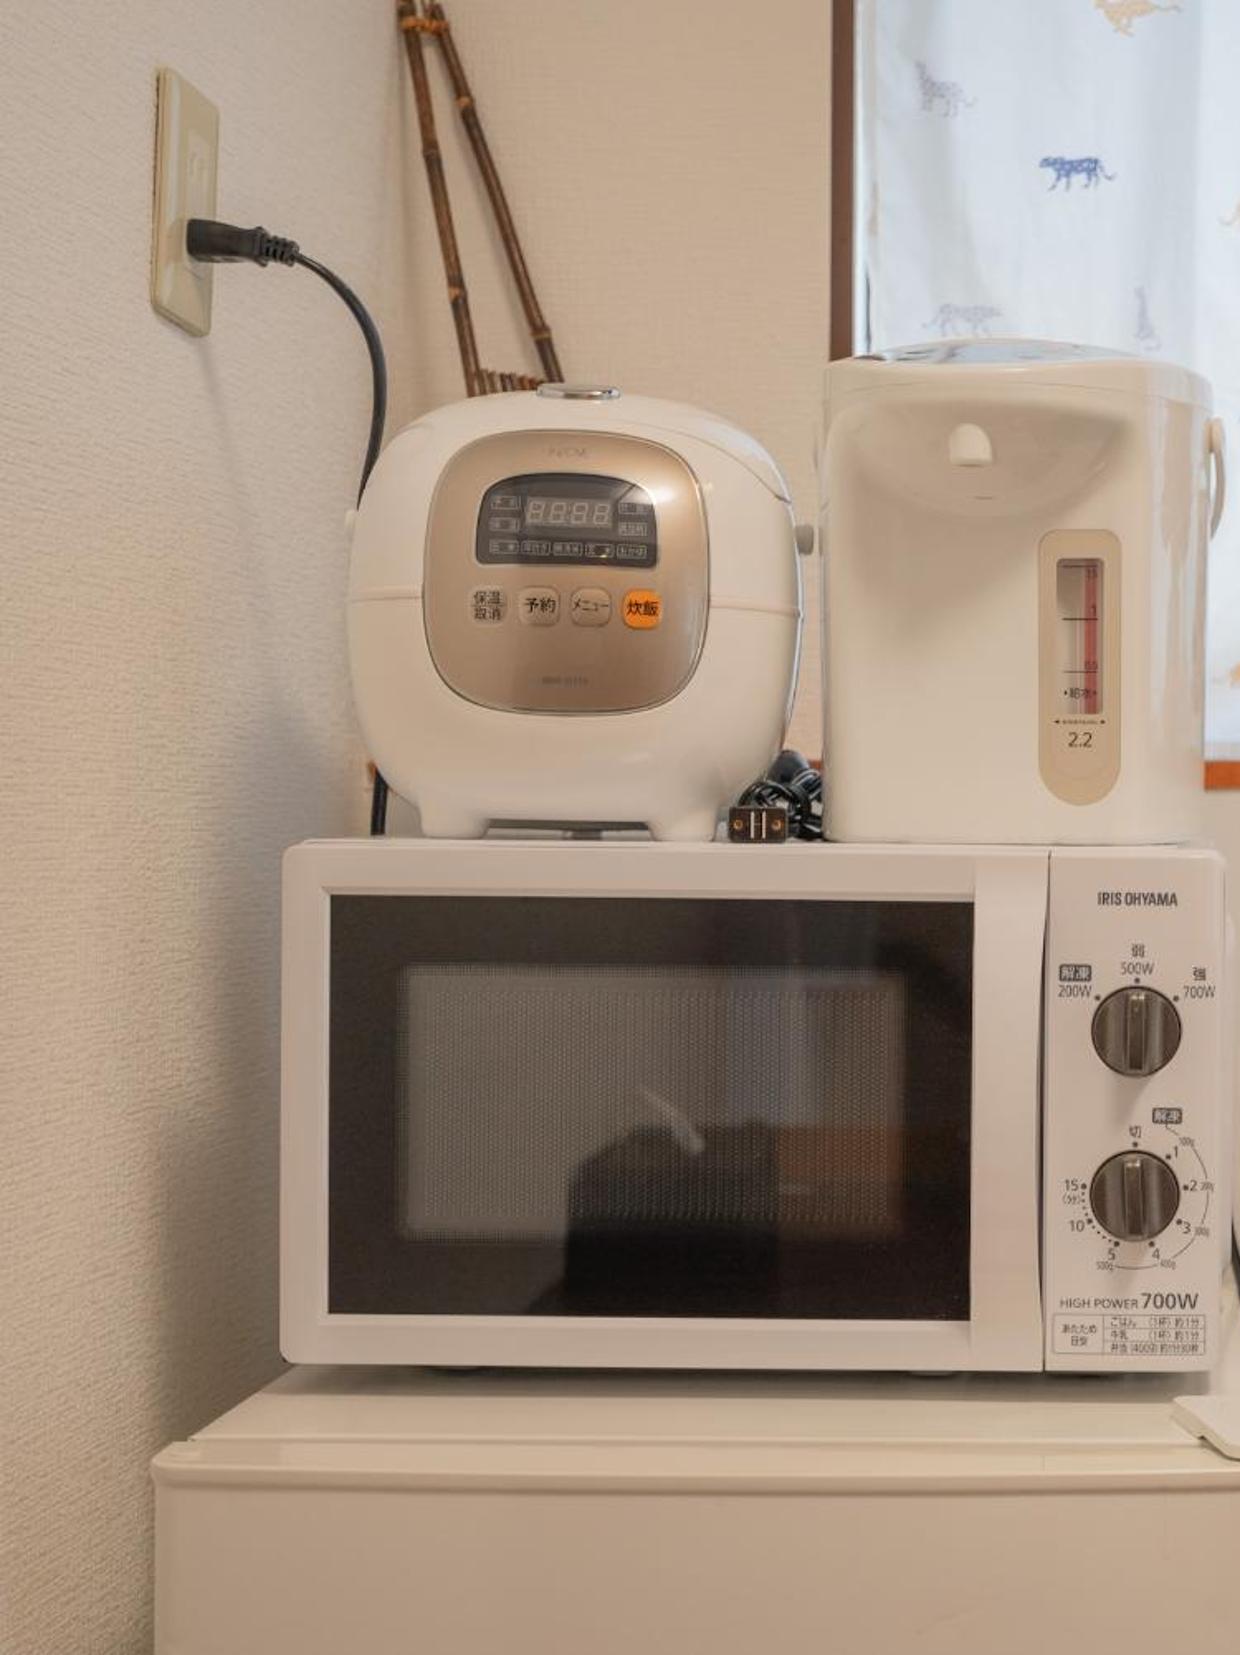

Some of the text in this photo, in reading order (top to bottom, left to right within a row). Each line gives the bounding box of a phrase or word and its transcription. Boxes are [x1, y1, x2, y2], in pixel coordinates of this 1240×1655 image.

[473, 591, 501, 604] 保温
[525, 597, 556, 615] 予約
[572, 598, 609, 612] メニュー
[626, 599, 659, 617] 炊飯
[474, 607, 501, 621] 取消
[1098, 892, 1178, 906] IRIS OHYAMA
[1120, 962, 1154, 975] 500W
[1058, 984, 1091, 998] 200W
[1184, 985, 1216, 998] 700W
[1129, 1126, 1142, 1138] 切
[1173, 1146, 1179, 1158] 1
[1065, 1179, 1079, 1192] 15
[1189, 1180, 1198, 1192] 2
[1070, 1219, 1085, 1232] 10
[1182, 1221, 1191, 1234] 3
[1108, 1248, 1116, 1261] 5
[1152, 1248, 1160, 1260] 4
[1060, 1293, 1199, 1309] HIGH POWER 700W
